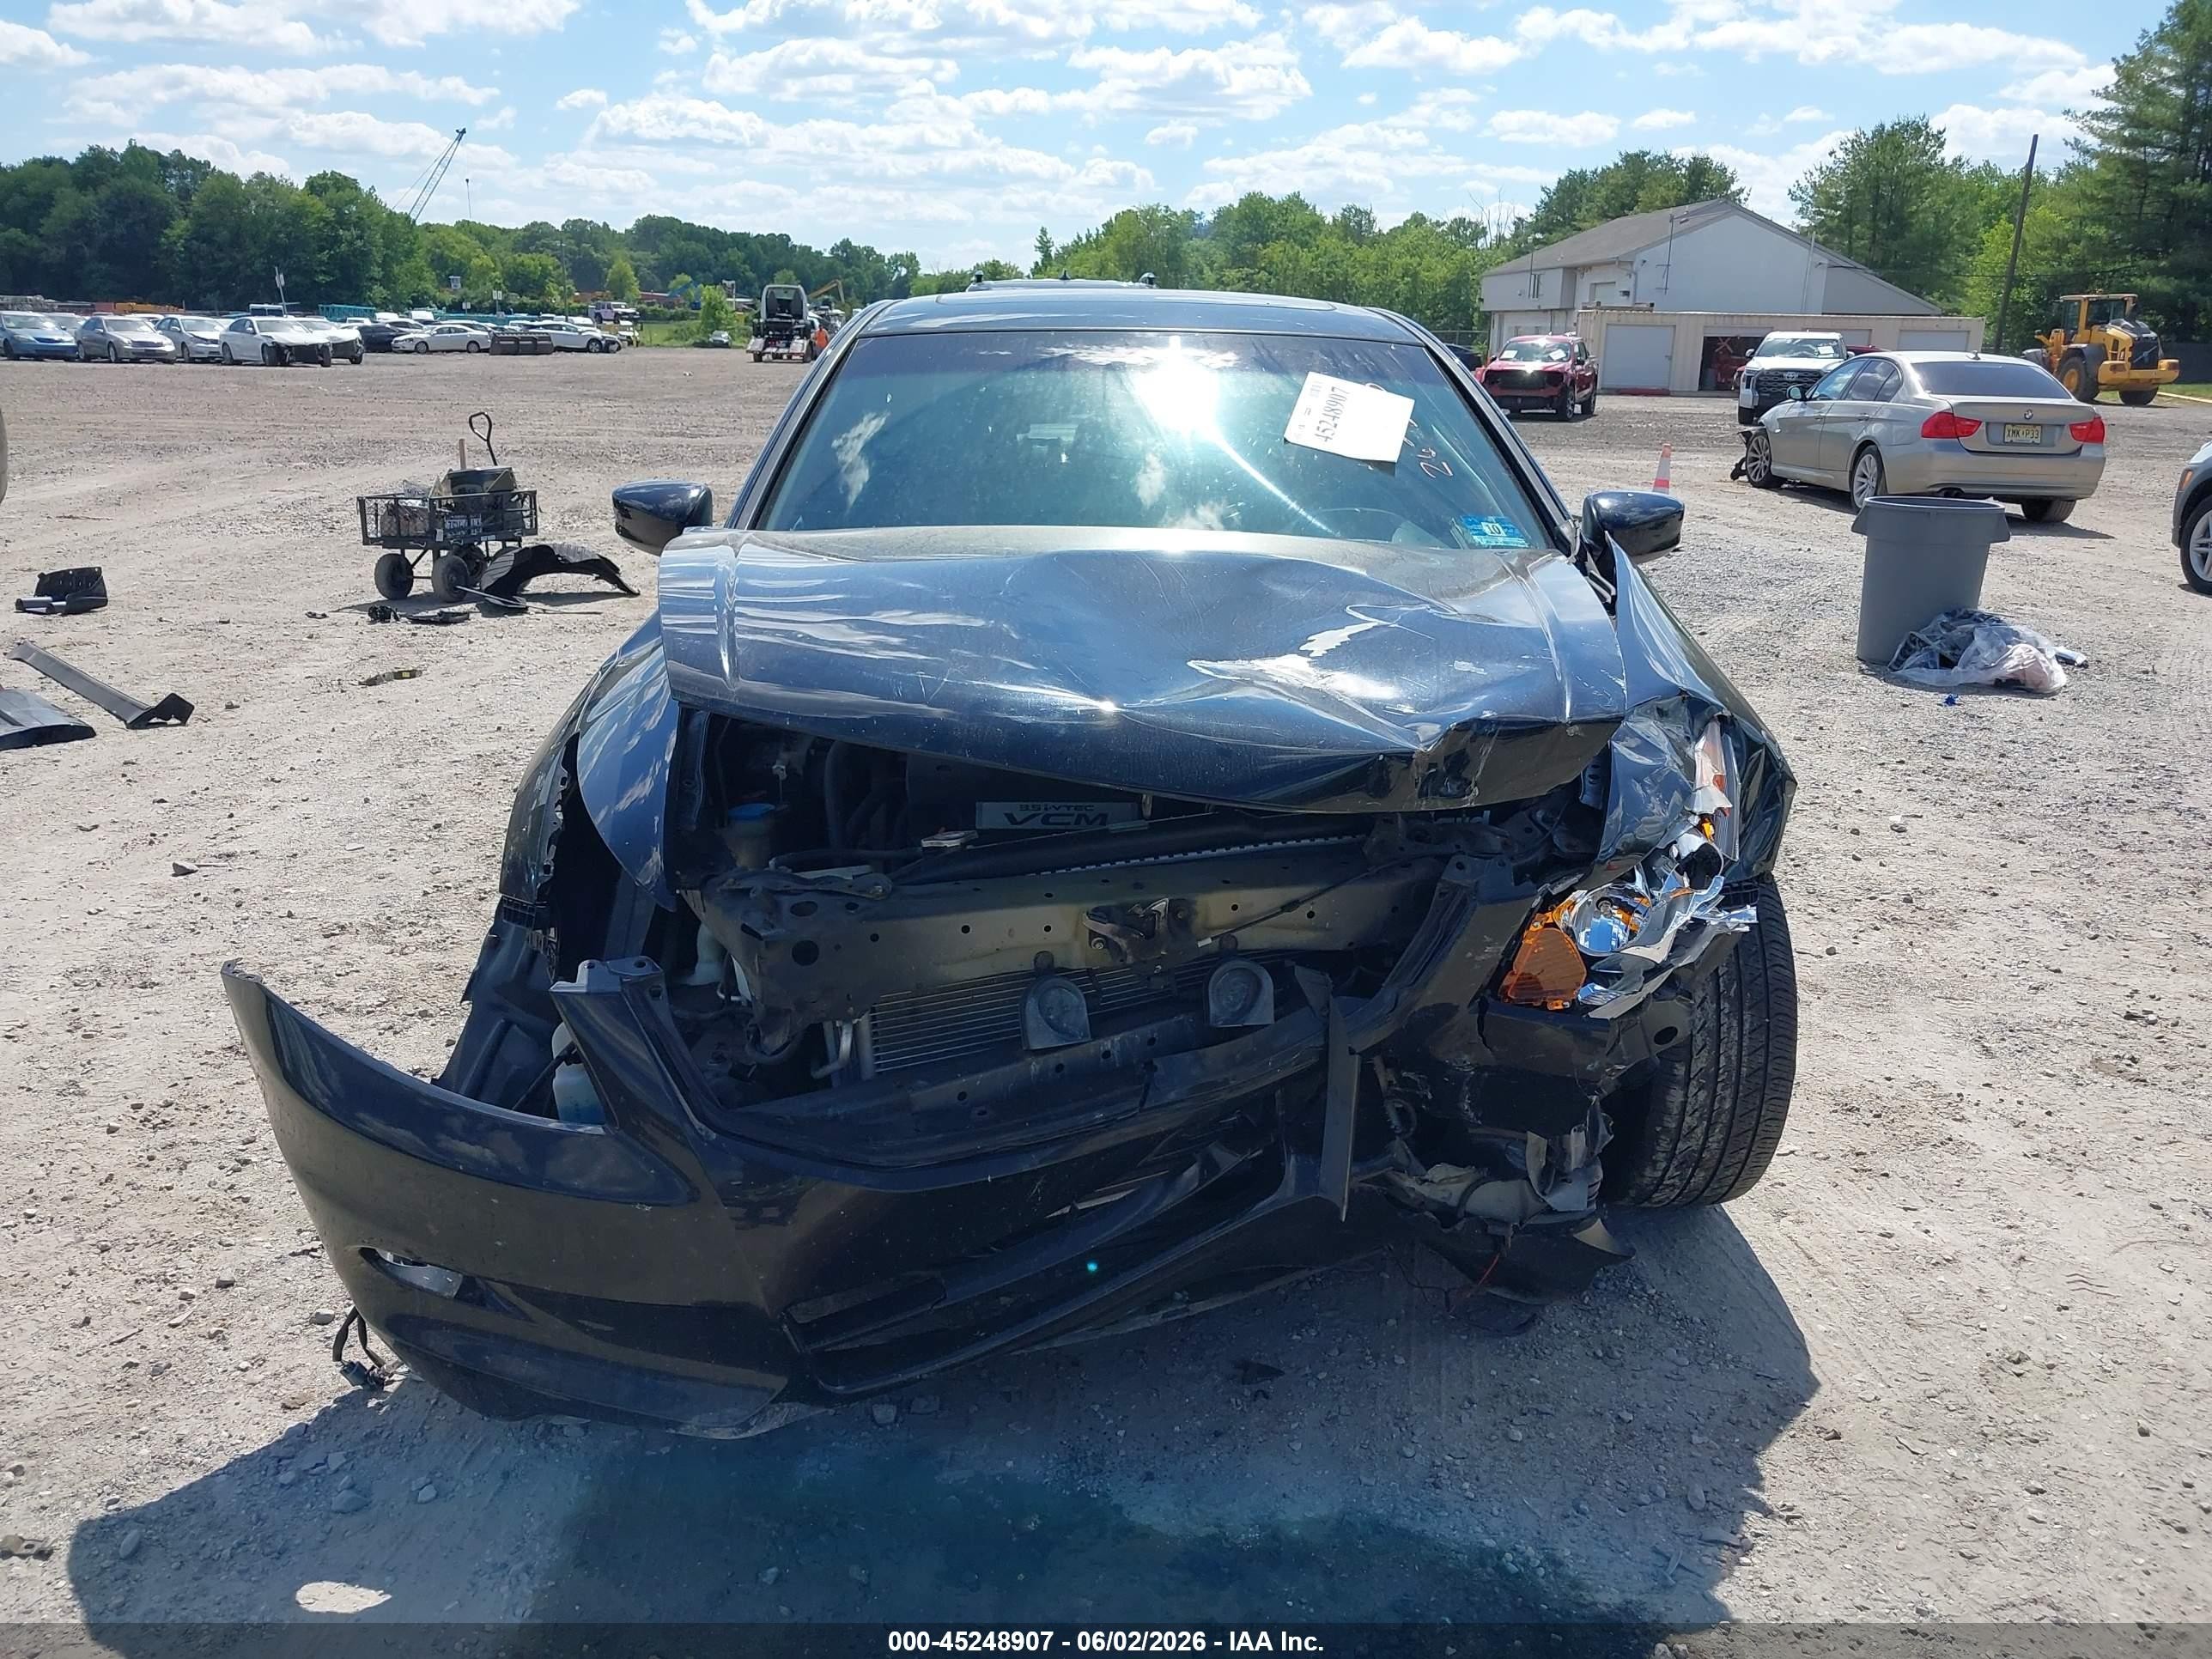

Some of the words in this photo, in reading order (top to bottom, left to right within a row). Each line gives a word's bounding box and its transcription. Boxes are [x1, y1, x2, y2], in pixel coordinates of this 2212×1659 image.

[1314, 386, 1352, 443] 45248907
[1485, 524, 1501, 534] 10
[1003, 812, 1109, 826] VCM
